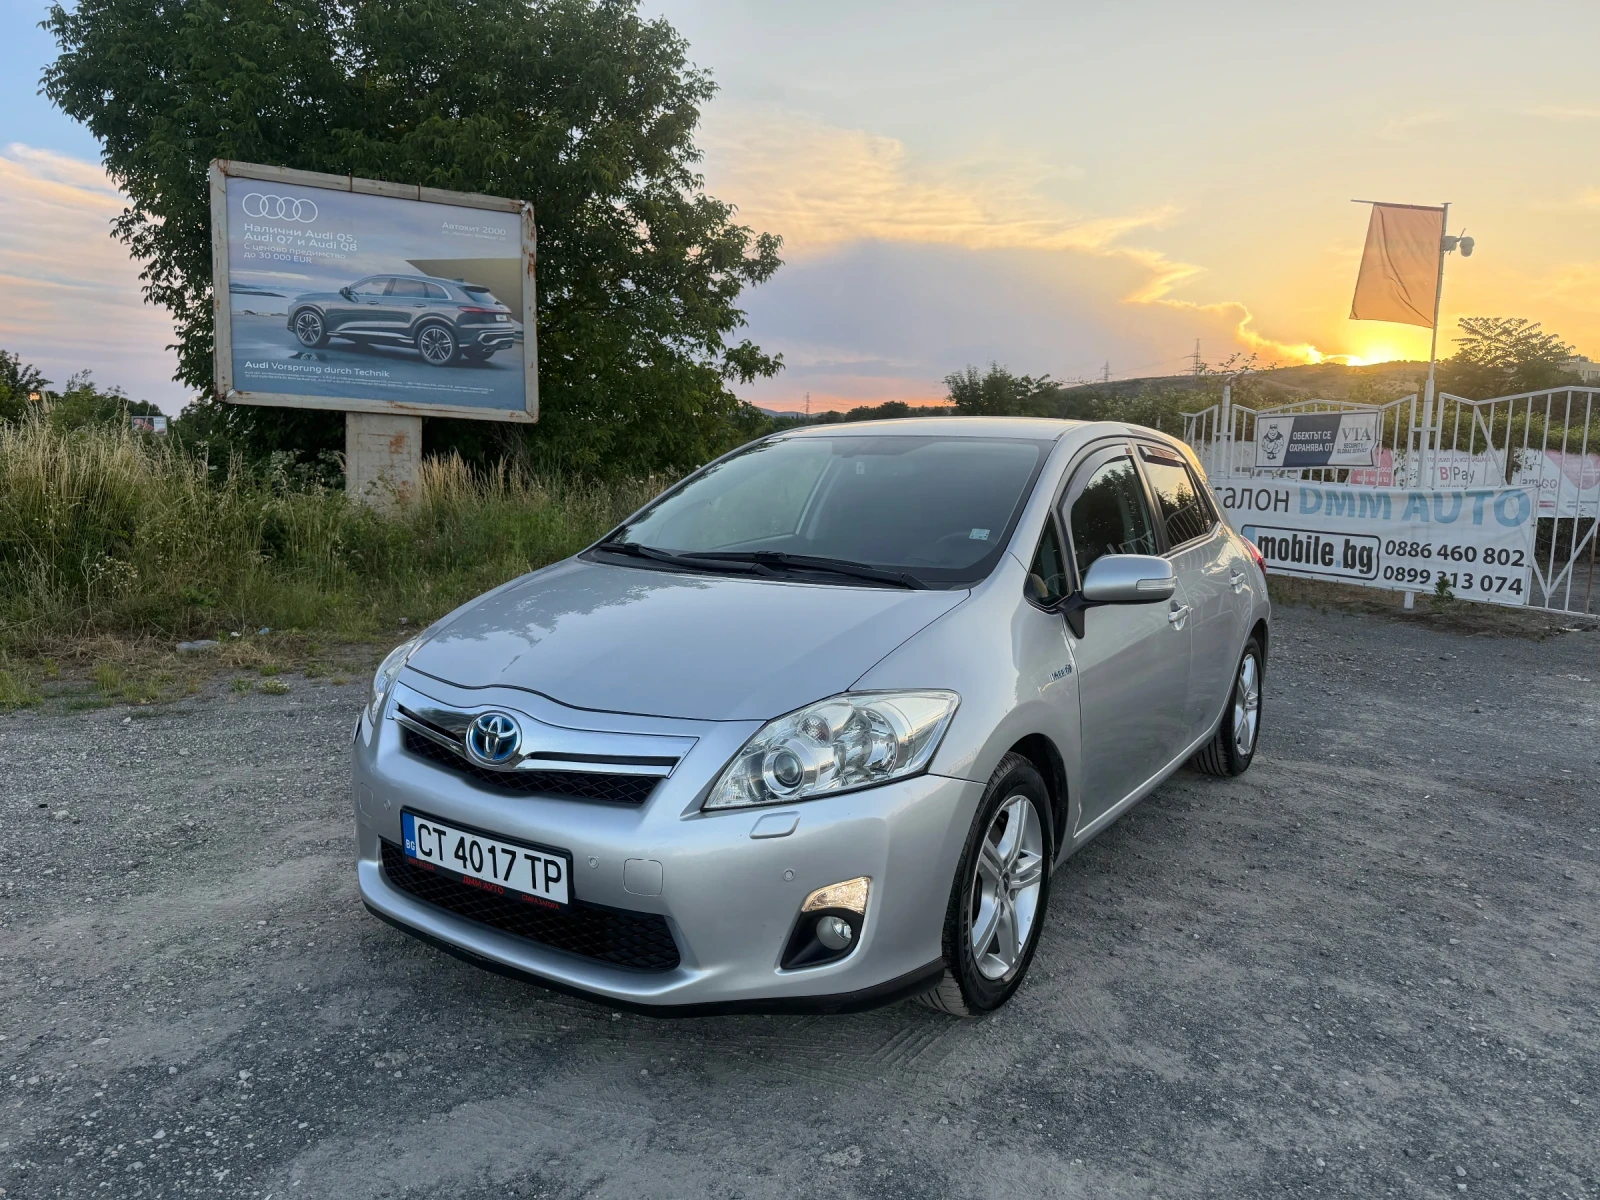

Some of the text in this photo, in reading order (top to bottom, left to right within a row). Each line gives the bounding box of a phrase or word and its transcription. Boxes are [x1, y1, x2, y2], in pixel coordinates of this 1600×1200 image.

[244, 223, 358, 244] Налични Audi Q5,
[442, 222, 480, 232] Автохит
[482, 226, 506, 236] 2000
[244, 232, 272, 242] Audi
[276, 235, 293, 244] Q7
[309, 239, 337, 249] Audi
[340, 242, 358, 252] Q8
[252, 244, 288, 254] ценово
[289, 248, 346, 260] предимство
[258, 252, 271, 260] 30
[273, 252, 291, 262] 000
[293, 256, 312, 264] EUR
[244, 361, 390, 378] Audi Vorsprung durch Technik
[1292, 430, 1332, 440] ОБЕКТЪТ СЕ
[1342, 427, 1372, 440] VTA
[1289, 442, 1334, 452] ОХРАНЯВА ОТ
[1300, 487, 1392, 520] DMM
[1402, 489, 1530, 527] AUTO
[1258, 534, 1524, 574] mobile.bg 0886 460 802
[1383, 566, 1430, 584] 0899
[1480, 575, 1523, 595] 074
[406, 839, 416, 850] BG
[418, 824, 562, 894] CT 4017 TP
[484, 883, 504, 894] АУТО
